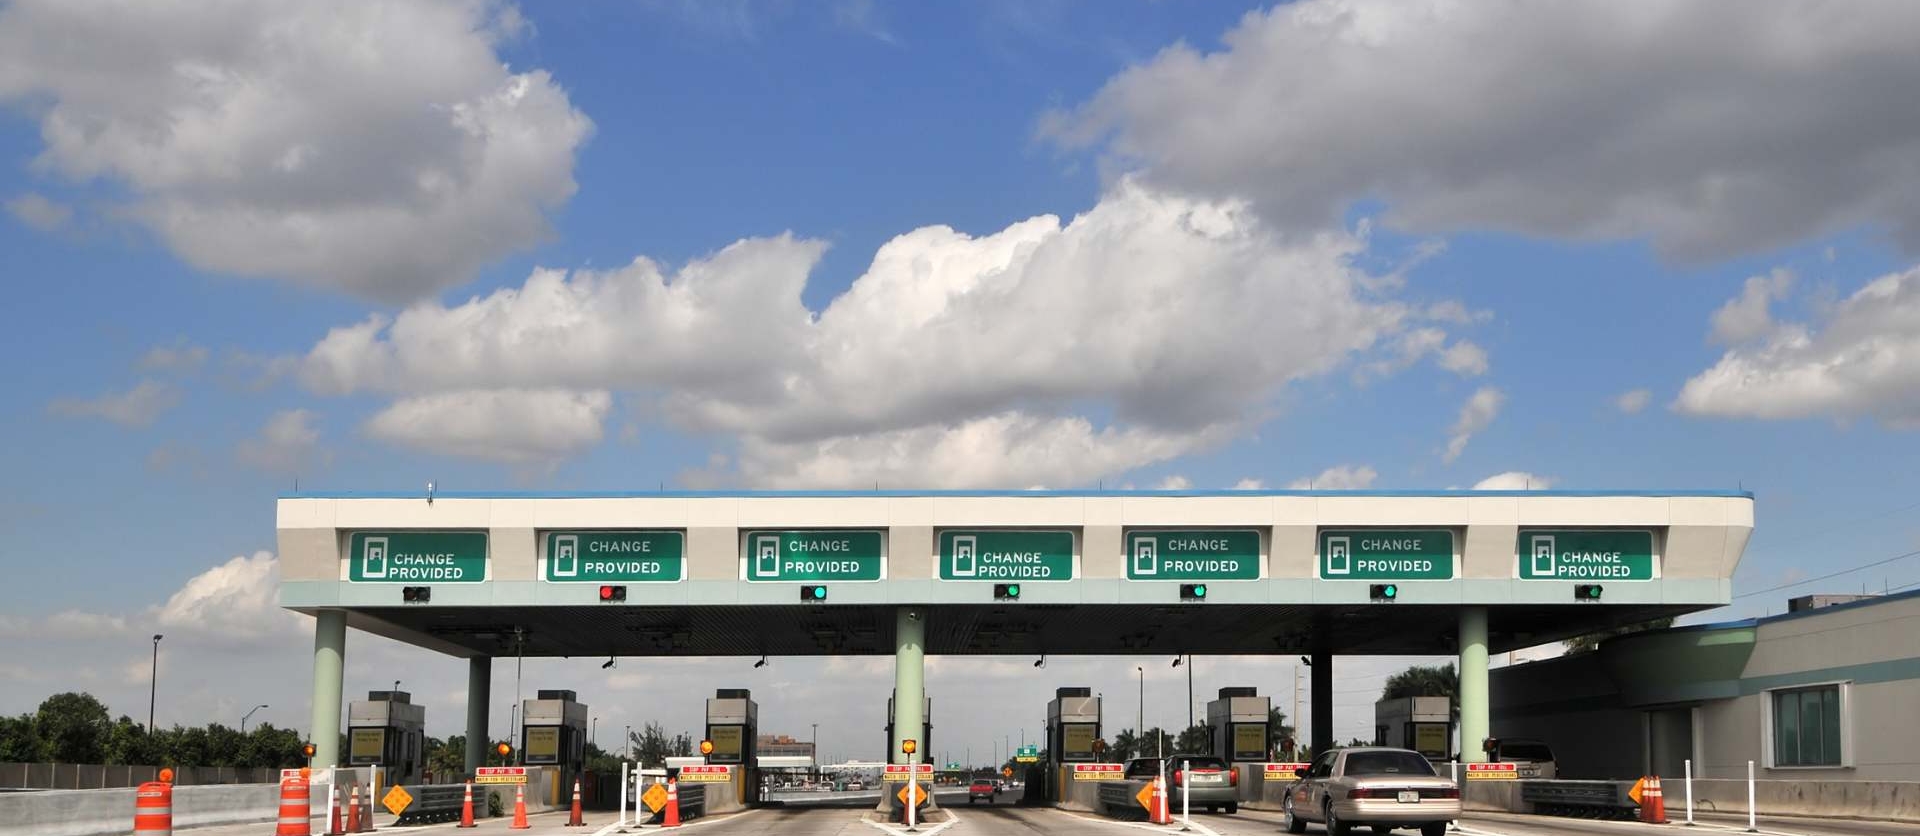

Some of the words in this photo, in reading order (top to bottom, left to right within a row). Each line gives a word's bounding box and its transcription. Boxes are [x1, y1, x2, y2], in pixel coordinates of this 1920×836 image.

[589, 541, 651, 552] CHANGE
[789, 540, 850, 551] CHANGE
[1168, 540, 1229, 551] CHANGE
[1361, 539, 1422, 551] CHANGE
[394, 554, 455, 565] CHANGE
[983, 552, 1042, 563] CHANGE
[1562, 552, 1621, 563] CHANGE
[585, 562, 661, 573] PROVIDED
[785, 561, 860, 573] PROVIDED
[978, 566, 1051, 577] PROVIDED
[1164, 561, 1239, 572] PROVIDED
[1357, 560, 1432, 572] PROVIDED
[1558, 565, 1631, 577] PROVIDED
[389, 567, 463, 579] PROVIDED
